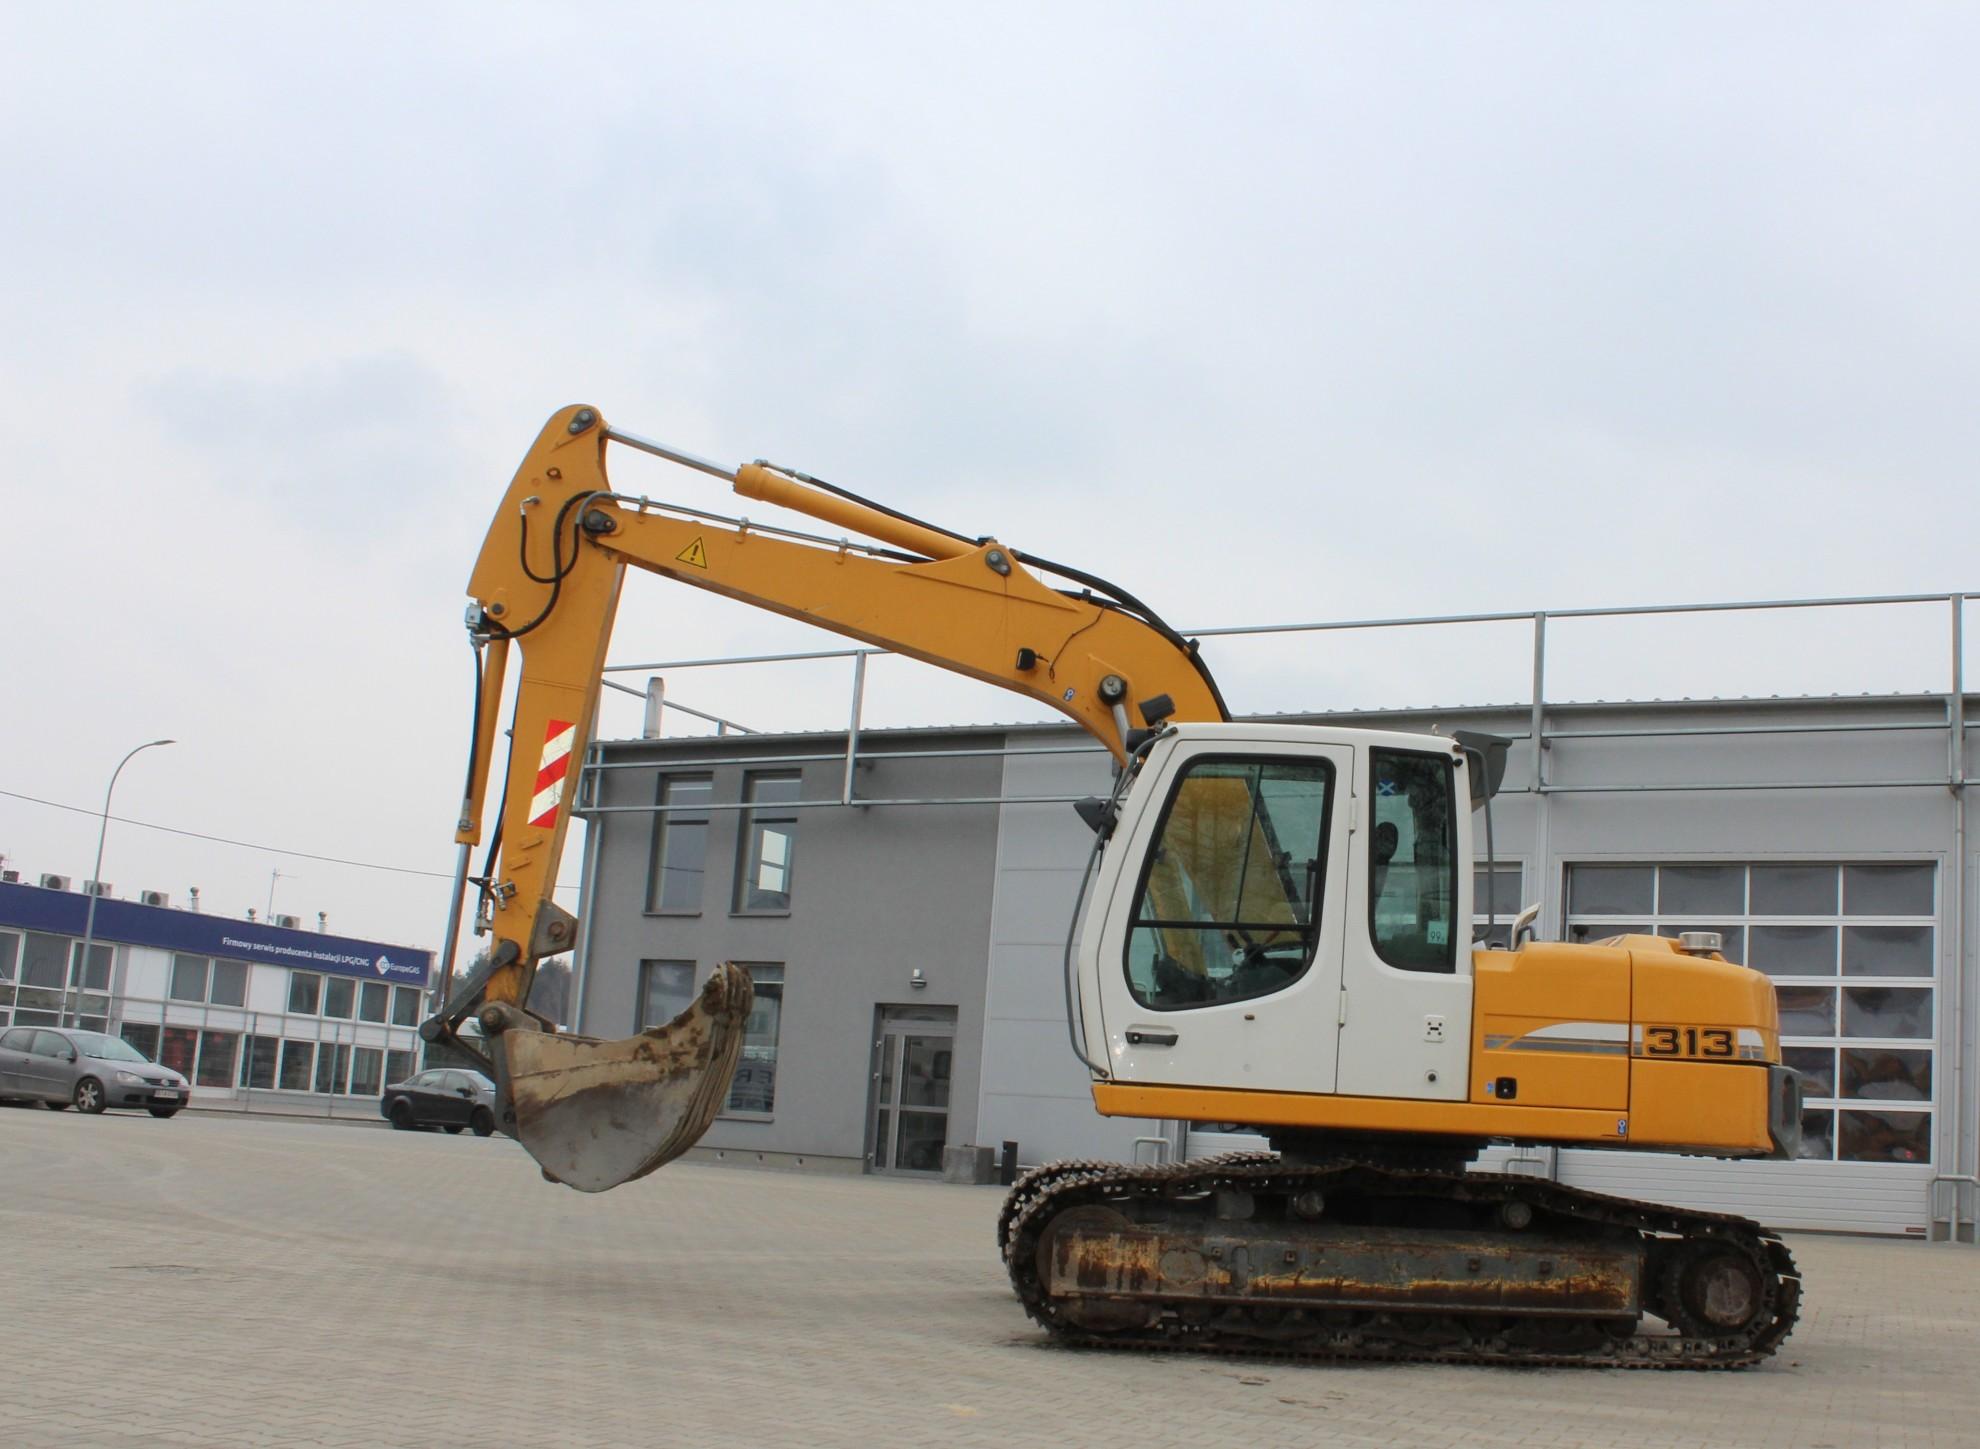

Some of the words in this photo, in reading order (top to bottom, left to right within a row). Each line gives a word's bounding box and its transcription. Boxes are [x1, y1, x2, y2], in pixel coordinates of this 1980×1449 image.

[223, 937, 252, 950] Firmowy
[253, 943, 275, 952] serwis
[275, 946, 312, 958] producenta
[313, 950, 341, 963] instalacji
[341, 955, 369, 967] LPG/CNG
[1647, 1027, 1733, 1056] 313
